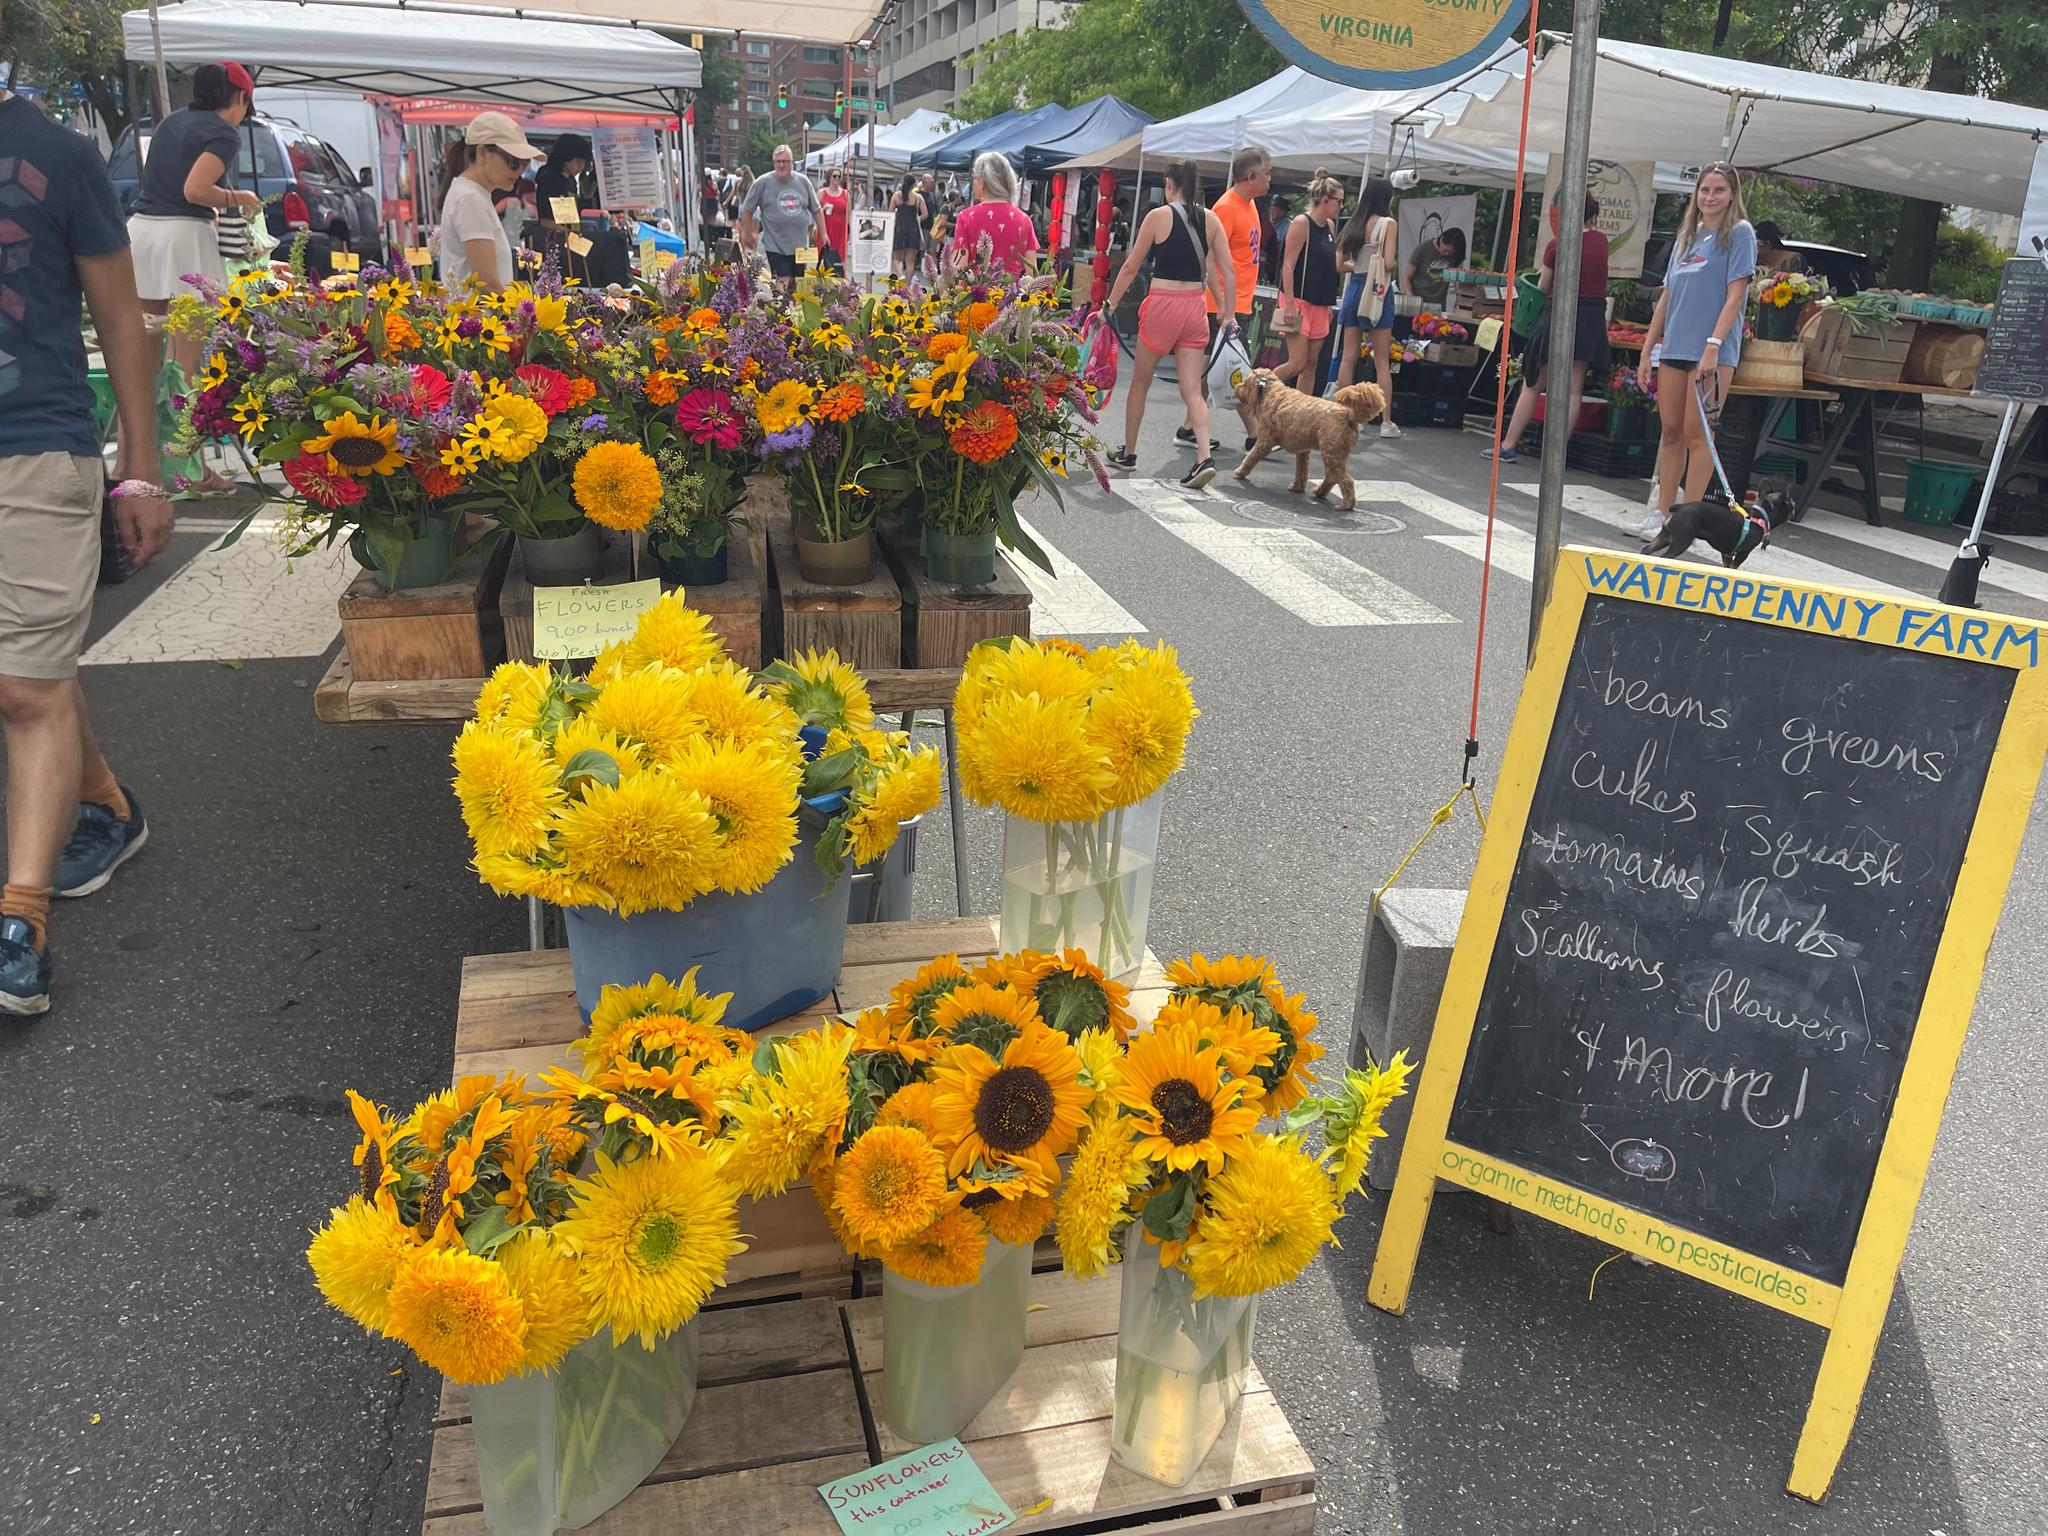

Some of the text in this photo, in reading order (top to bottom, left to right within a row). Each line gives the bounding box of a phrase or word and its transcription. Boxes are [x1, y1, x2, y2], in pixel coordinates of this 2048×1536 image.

[1424, 0, 1502, 15] NTY
[1319, 13, 1413, 48] VIRGINIA
[1599, 197, 1631, 208] OMAC
[1599, 208, 1632, 220] TABLE
[536, 597, 646, 618] FLOWERS
[1585, 556, 2039, 668] WATERPENNY FARM
[546, 622, 635, 639] 9.00 bunch
[570, 644, 601, 657] Pest
[1603, 666, 1945, 783] beans greens
[1705, 968, 1852, 1052] flowers
[1442, 1151, 1808, 1306] organic methods no pesticides
[827, 1444, 964, 1509] SUNFLOWERS
[850, 1473, 949, 1524] this container
